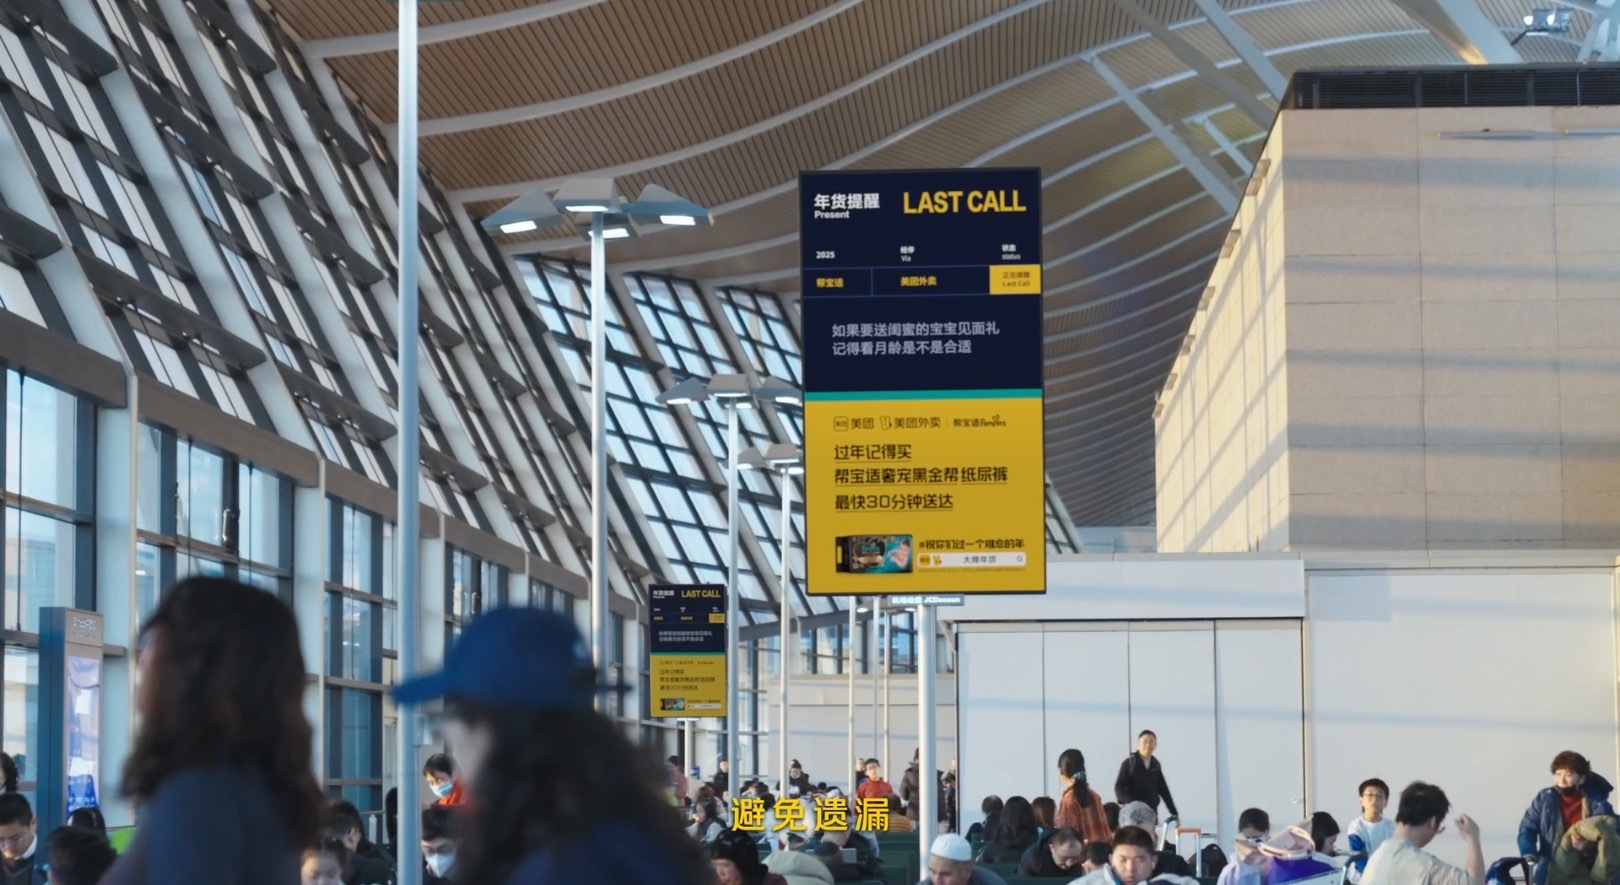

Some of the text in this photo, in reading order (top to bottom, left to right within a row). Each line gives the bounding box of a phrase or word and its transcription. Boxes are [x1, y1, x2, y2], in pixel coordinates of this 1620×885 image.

[814, 193, 880, 210] 年货提醒
[903, 190, 1027, 214] LAST CALL
[814, 210, 850, 219] Present
[816, 251, 835, 259] 2025
[1002, 244, 1016, 252] 状态
[816, 278, 844, 288] 帮宝适
[900, 276, 937, 286] 美团外卖
[832, 321, 1000, 337] 如果要送闺蜜的宝宝见面礼
[832, 340, 972, 355] 记得看月龄是不是合适
[851, 417, 875, 429] 美团
[894, 416, 941, 428] 美团外卖
[834, 444, 912, 460] 过年记得买
[834, 466, 1008, 484] 帮宝适奢宠黑金帮 纸尿裤
[835, 494, 953, 510] 最快30分钟送达
[919, 539, 1024, 549] #祝你们过一个难忘的年
